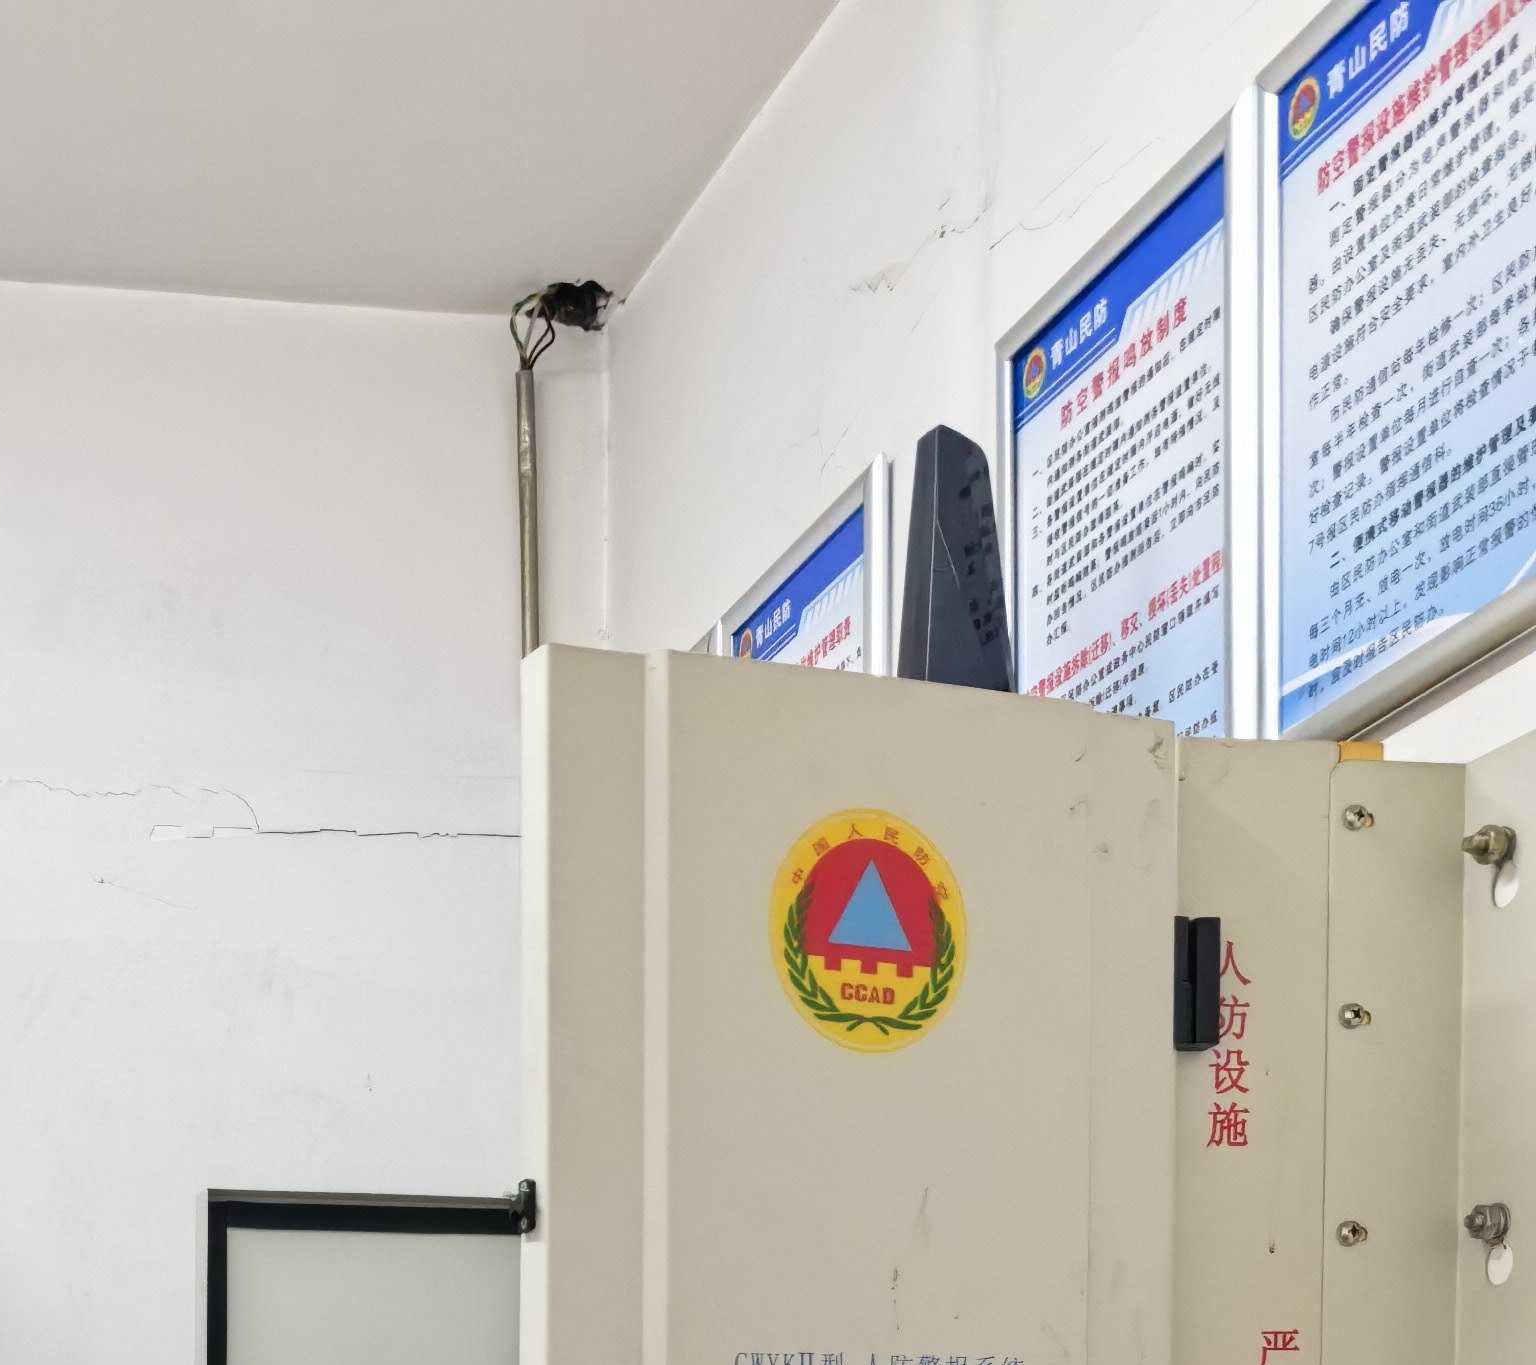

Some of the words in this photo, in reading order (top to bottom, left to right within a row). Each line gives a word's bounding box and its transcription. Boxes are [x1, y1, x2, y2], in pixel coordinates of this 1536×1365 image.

[1327, 2, 1409, 99] 青山民防
[1050, 297, 1107, 370] 青山民防
[1060, 295, 1187, 430] 防空警报鸣放制度
[756, 598, 791, 648] 青山民防
[840, 982, 896, 1006] CCAD
[1206, 940, 1252, 1149] 人防设施
